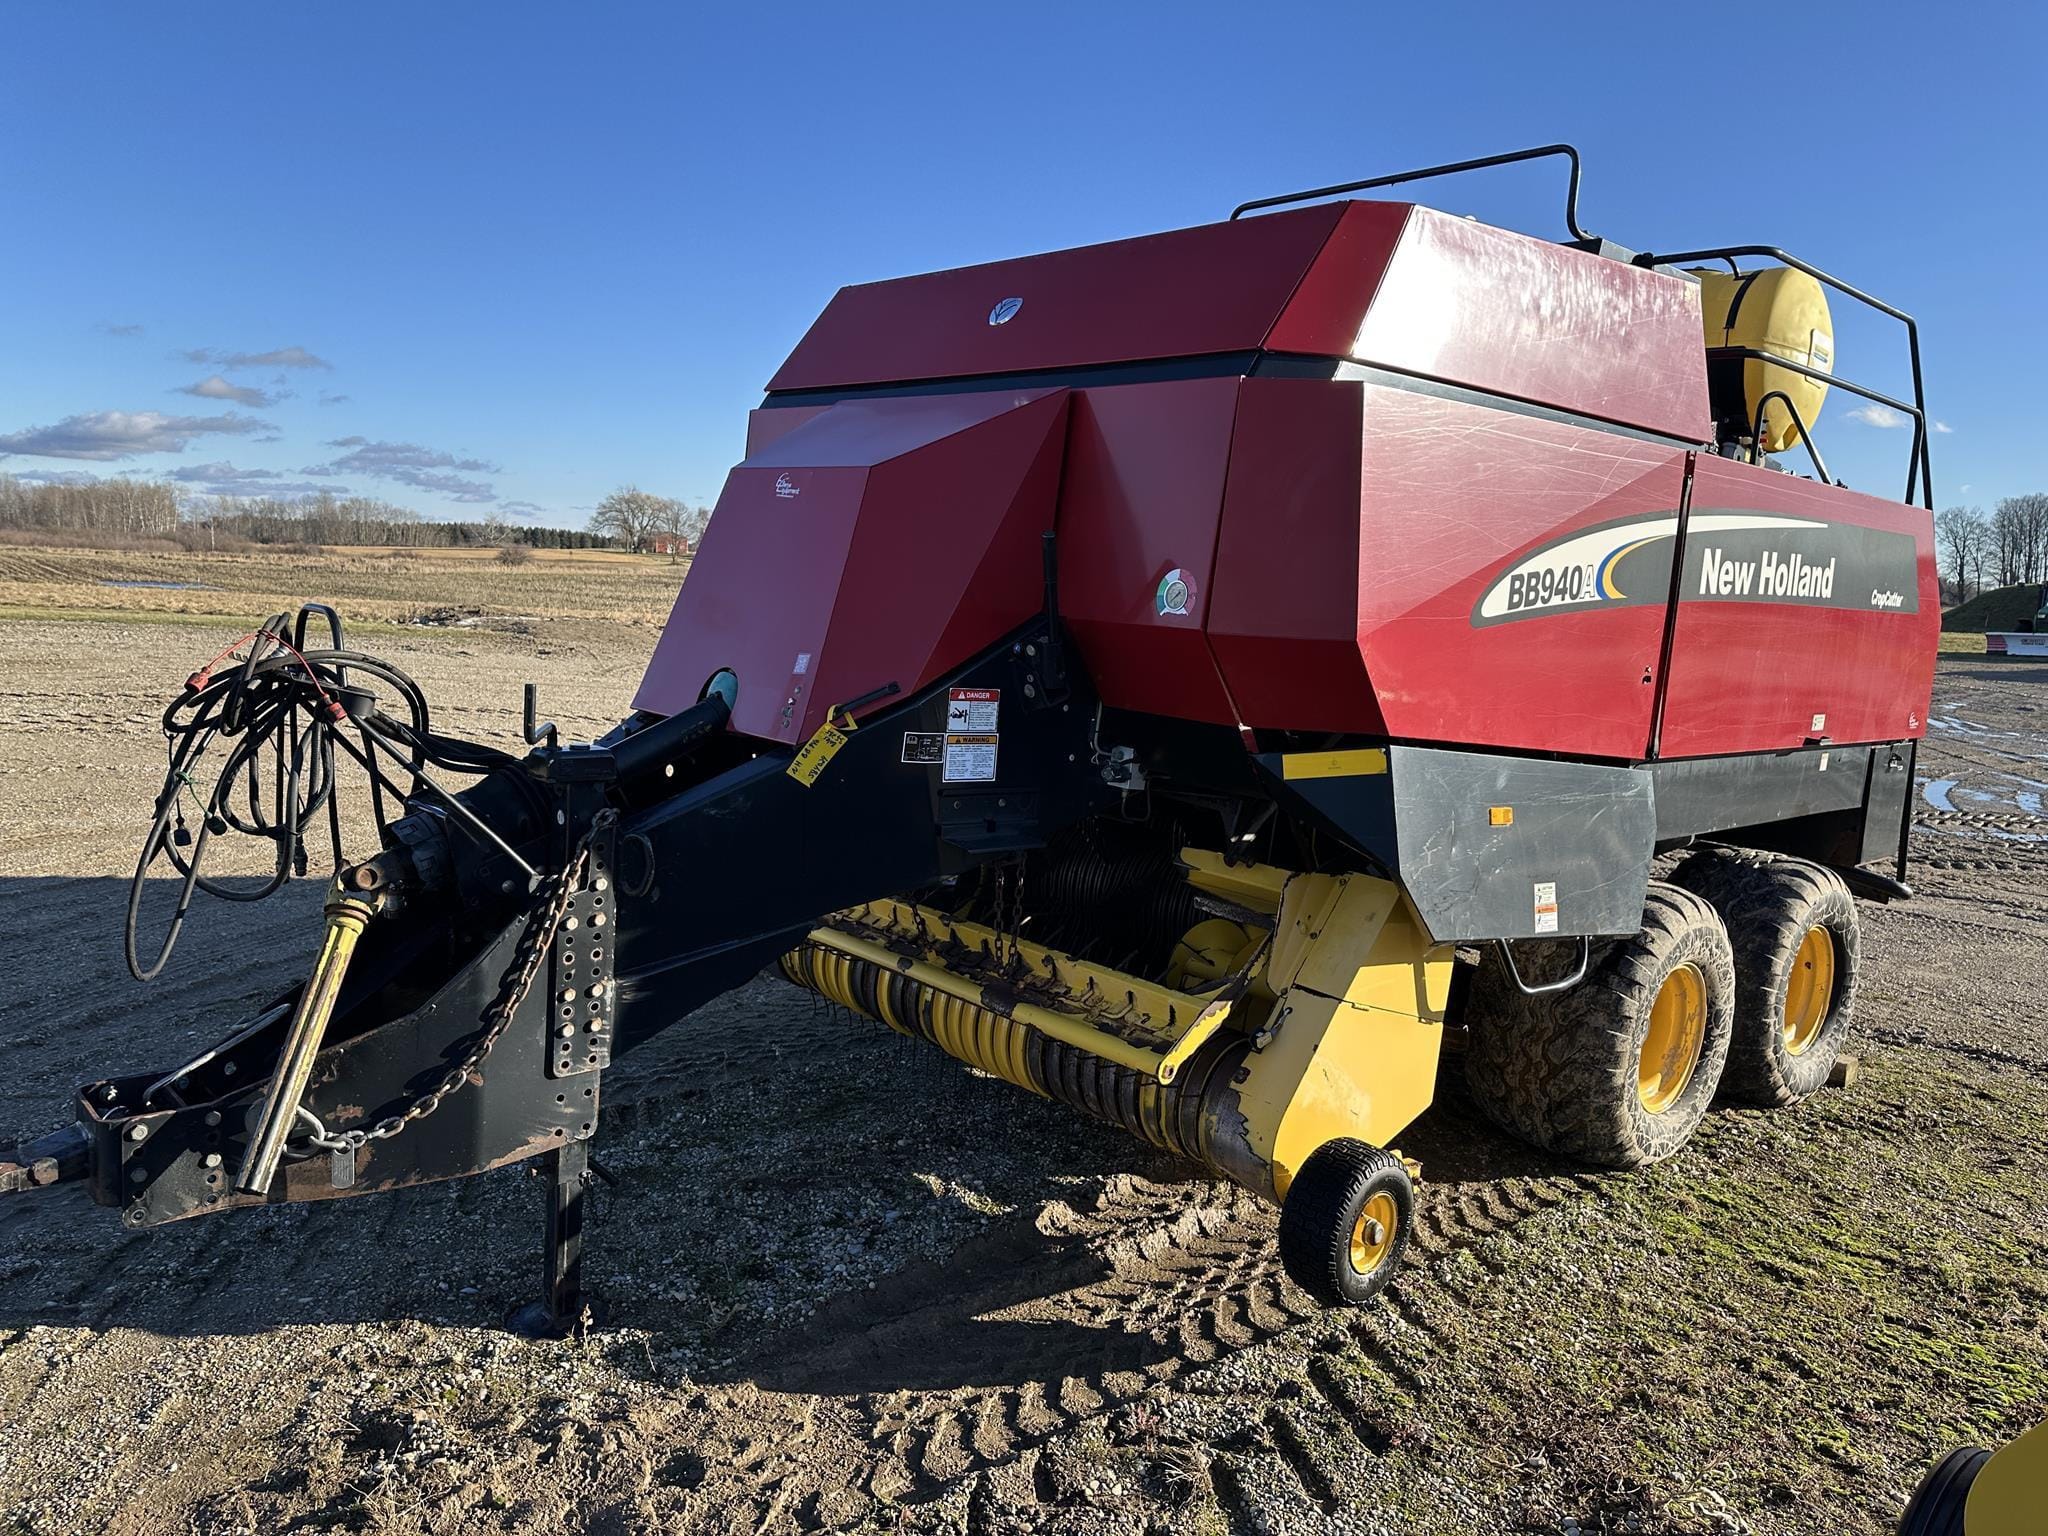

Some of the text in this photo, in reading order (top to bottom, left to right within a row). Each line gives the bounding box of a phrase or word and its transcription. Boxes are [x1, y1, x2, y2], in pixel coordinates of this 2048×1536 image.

[1507, 565, 1595, 610] BB940A
[1700, 548, 1835, 599] New Holland
